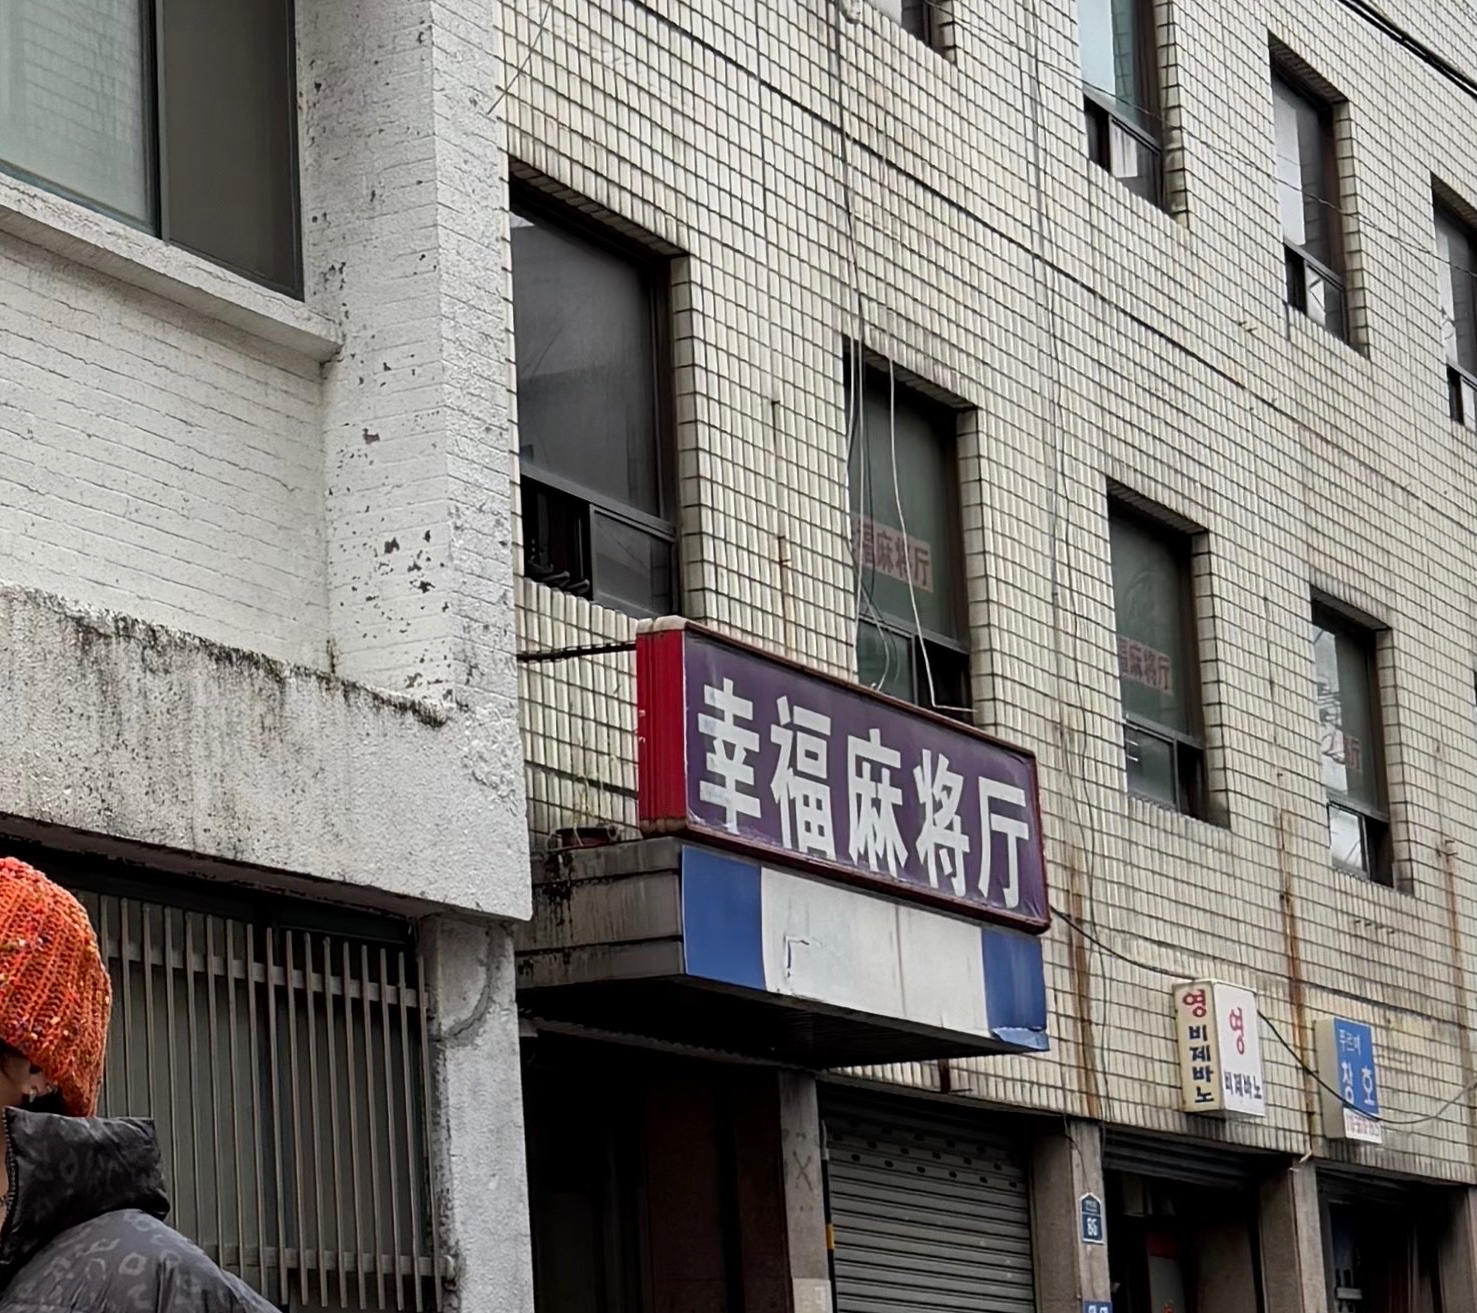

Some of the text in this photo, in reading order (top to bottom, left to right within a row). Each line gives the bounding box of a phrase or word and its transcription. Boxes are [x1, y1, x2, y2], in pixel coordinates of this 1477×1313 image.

[697, 677, 1030, 909] 幸福麻将厅
[1182, 989, 1215, 1103] 영 비제바노
[1229, 1007, 1245, 1055] 영
